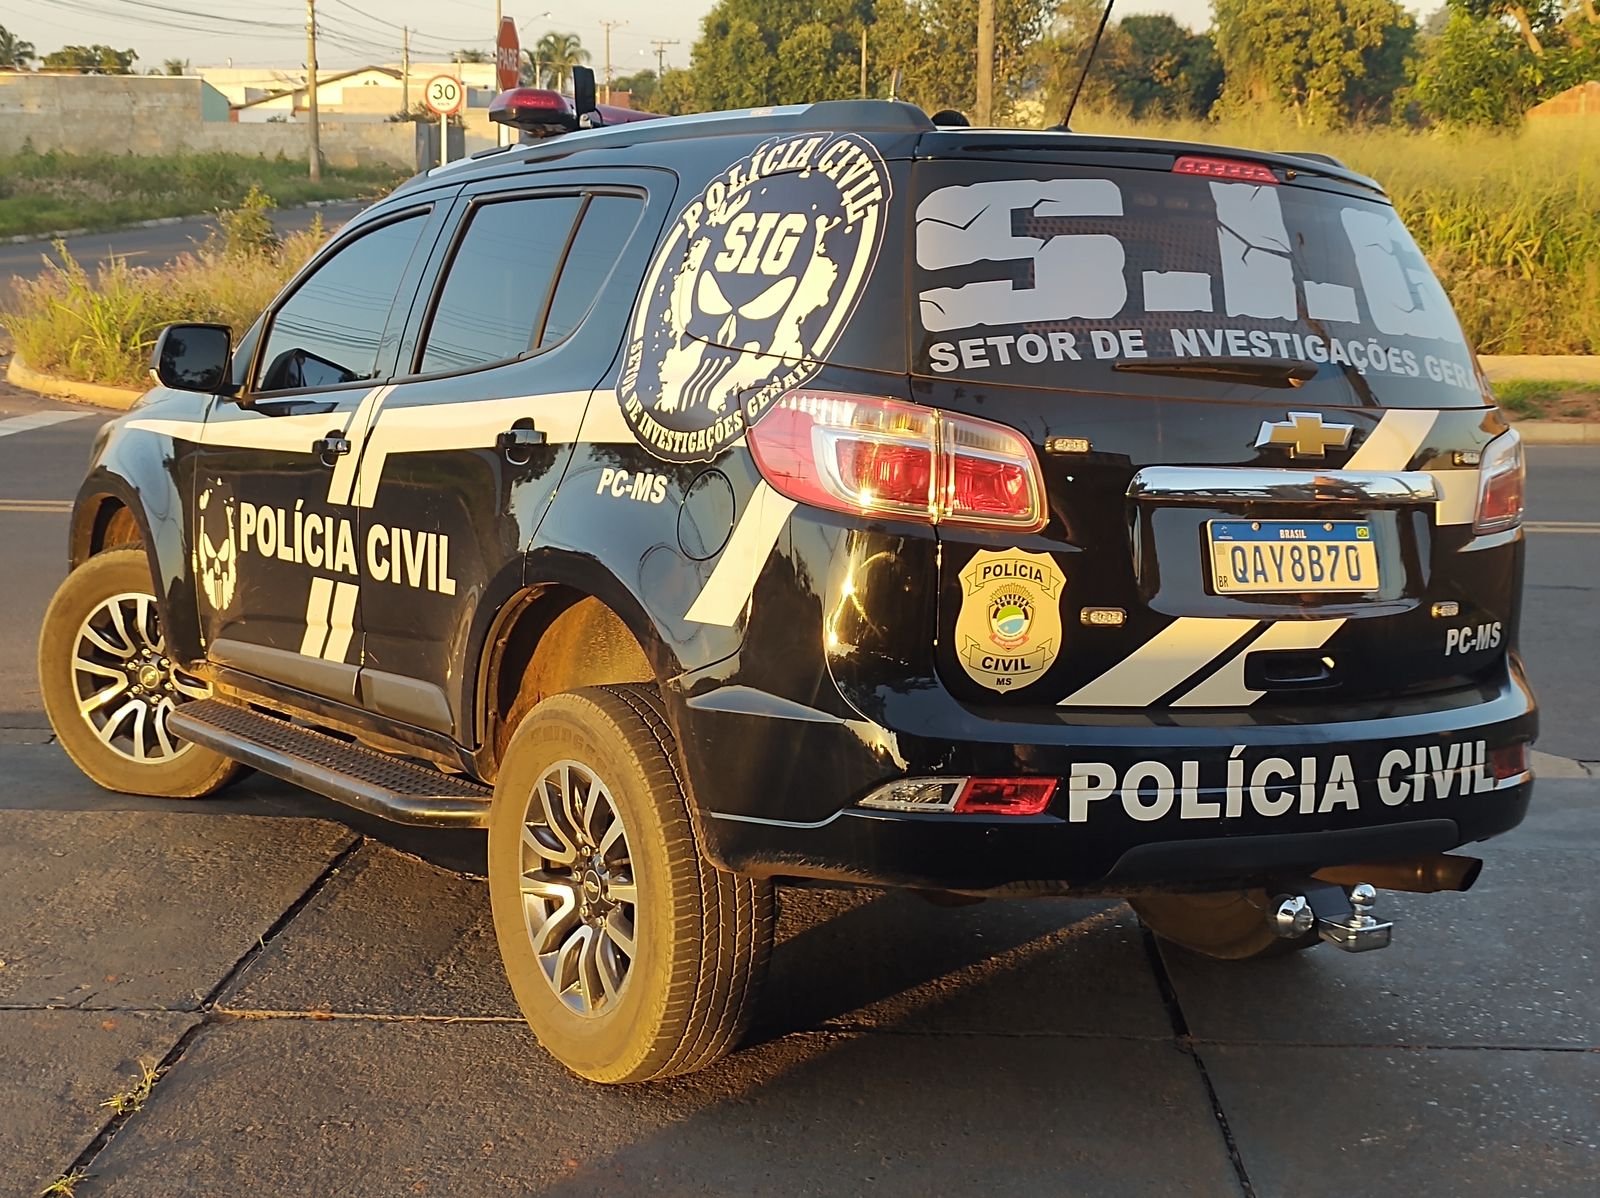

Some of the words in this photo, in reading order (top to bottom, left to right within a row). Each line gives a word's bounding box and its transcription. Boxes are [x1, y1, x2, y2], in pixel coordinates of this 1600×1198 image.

[499, 47, 519, 72] PARE
[432, 84, 456, 100] 30
[682, 137, 823, 238] POLÍCIA
[818, 139, 883, 225] CIVIL
[713, 212, 808, 276] SIG
[620, 340, 644, 397] SETOR
[929, 331, 1078, 374] SETOR
[1092, 329, 1148, 360] DE
[745, 353, 818, 418] GERAIS
[625, 396, 638, 420] DE
[638, 409, 744, 453] INVESTIGAÇÕES
[596, 468, 668, 504] PC-MS
[240, 499, 359, 576] POLÍCIA
[366, 523, 457, 596] CIVIL
[1279, 529, 1307, 539] BRASIL
[982, 560, 1044, 583] POLÍCIA
[1218, 575, 1229, 588] BR
[1230, 545, 1361, 584] QAY8B70
[1445, 621, 1502, 656] PC-MS
[981, 656, 1031, 671] CIVIL
[995, 678, 1012, 686] MS
[1068, 744, 1361, 823] POLÍCIA
[1377, 740, 1500, 806] CIVIL
